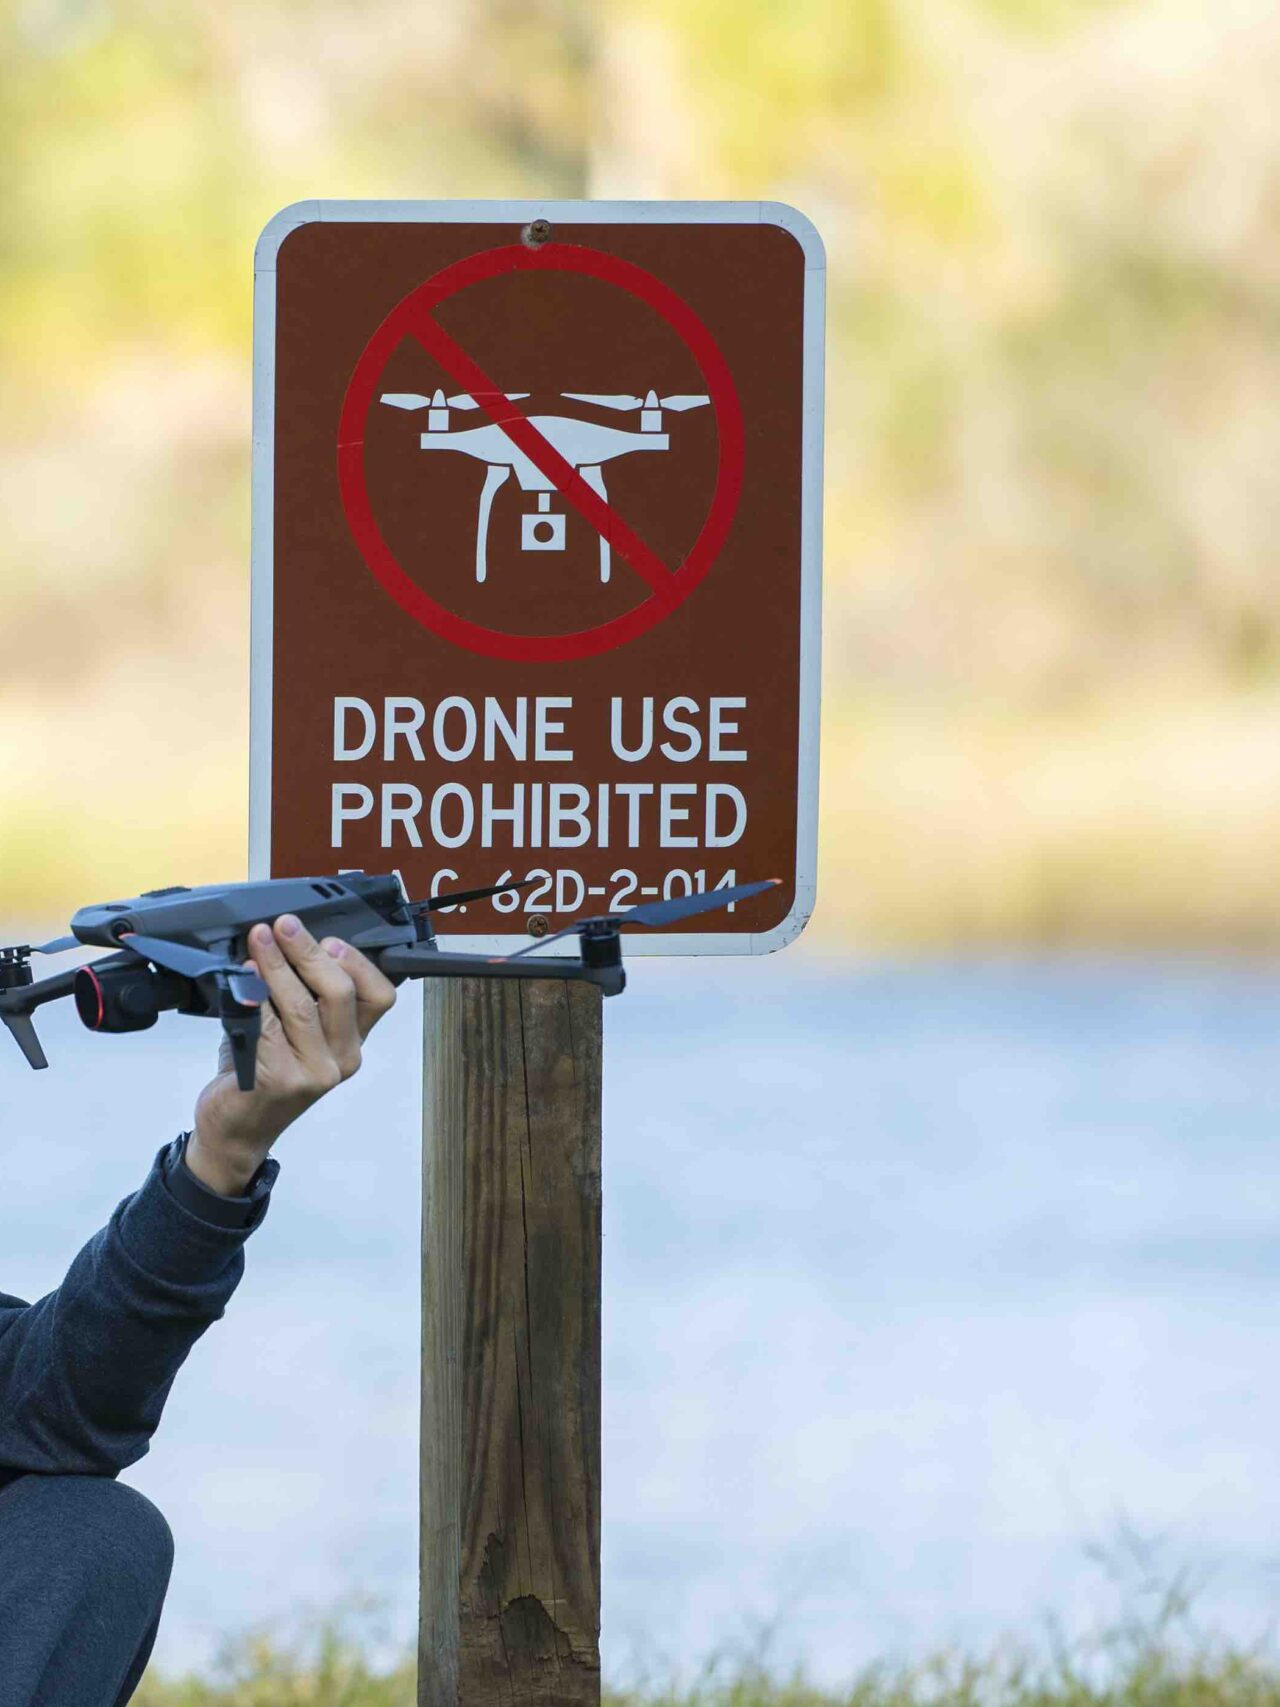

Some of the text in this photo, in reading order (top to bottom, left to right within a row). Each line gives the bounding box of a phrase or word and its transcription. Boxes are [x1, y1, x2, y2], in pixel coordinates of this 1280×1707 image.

[334, 696, 747, 762] DRONE USE
[332, 783, 747, 848] PROHIBITED
